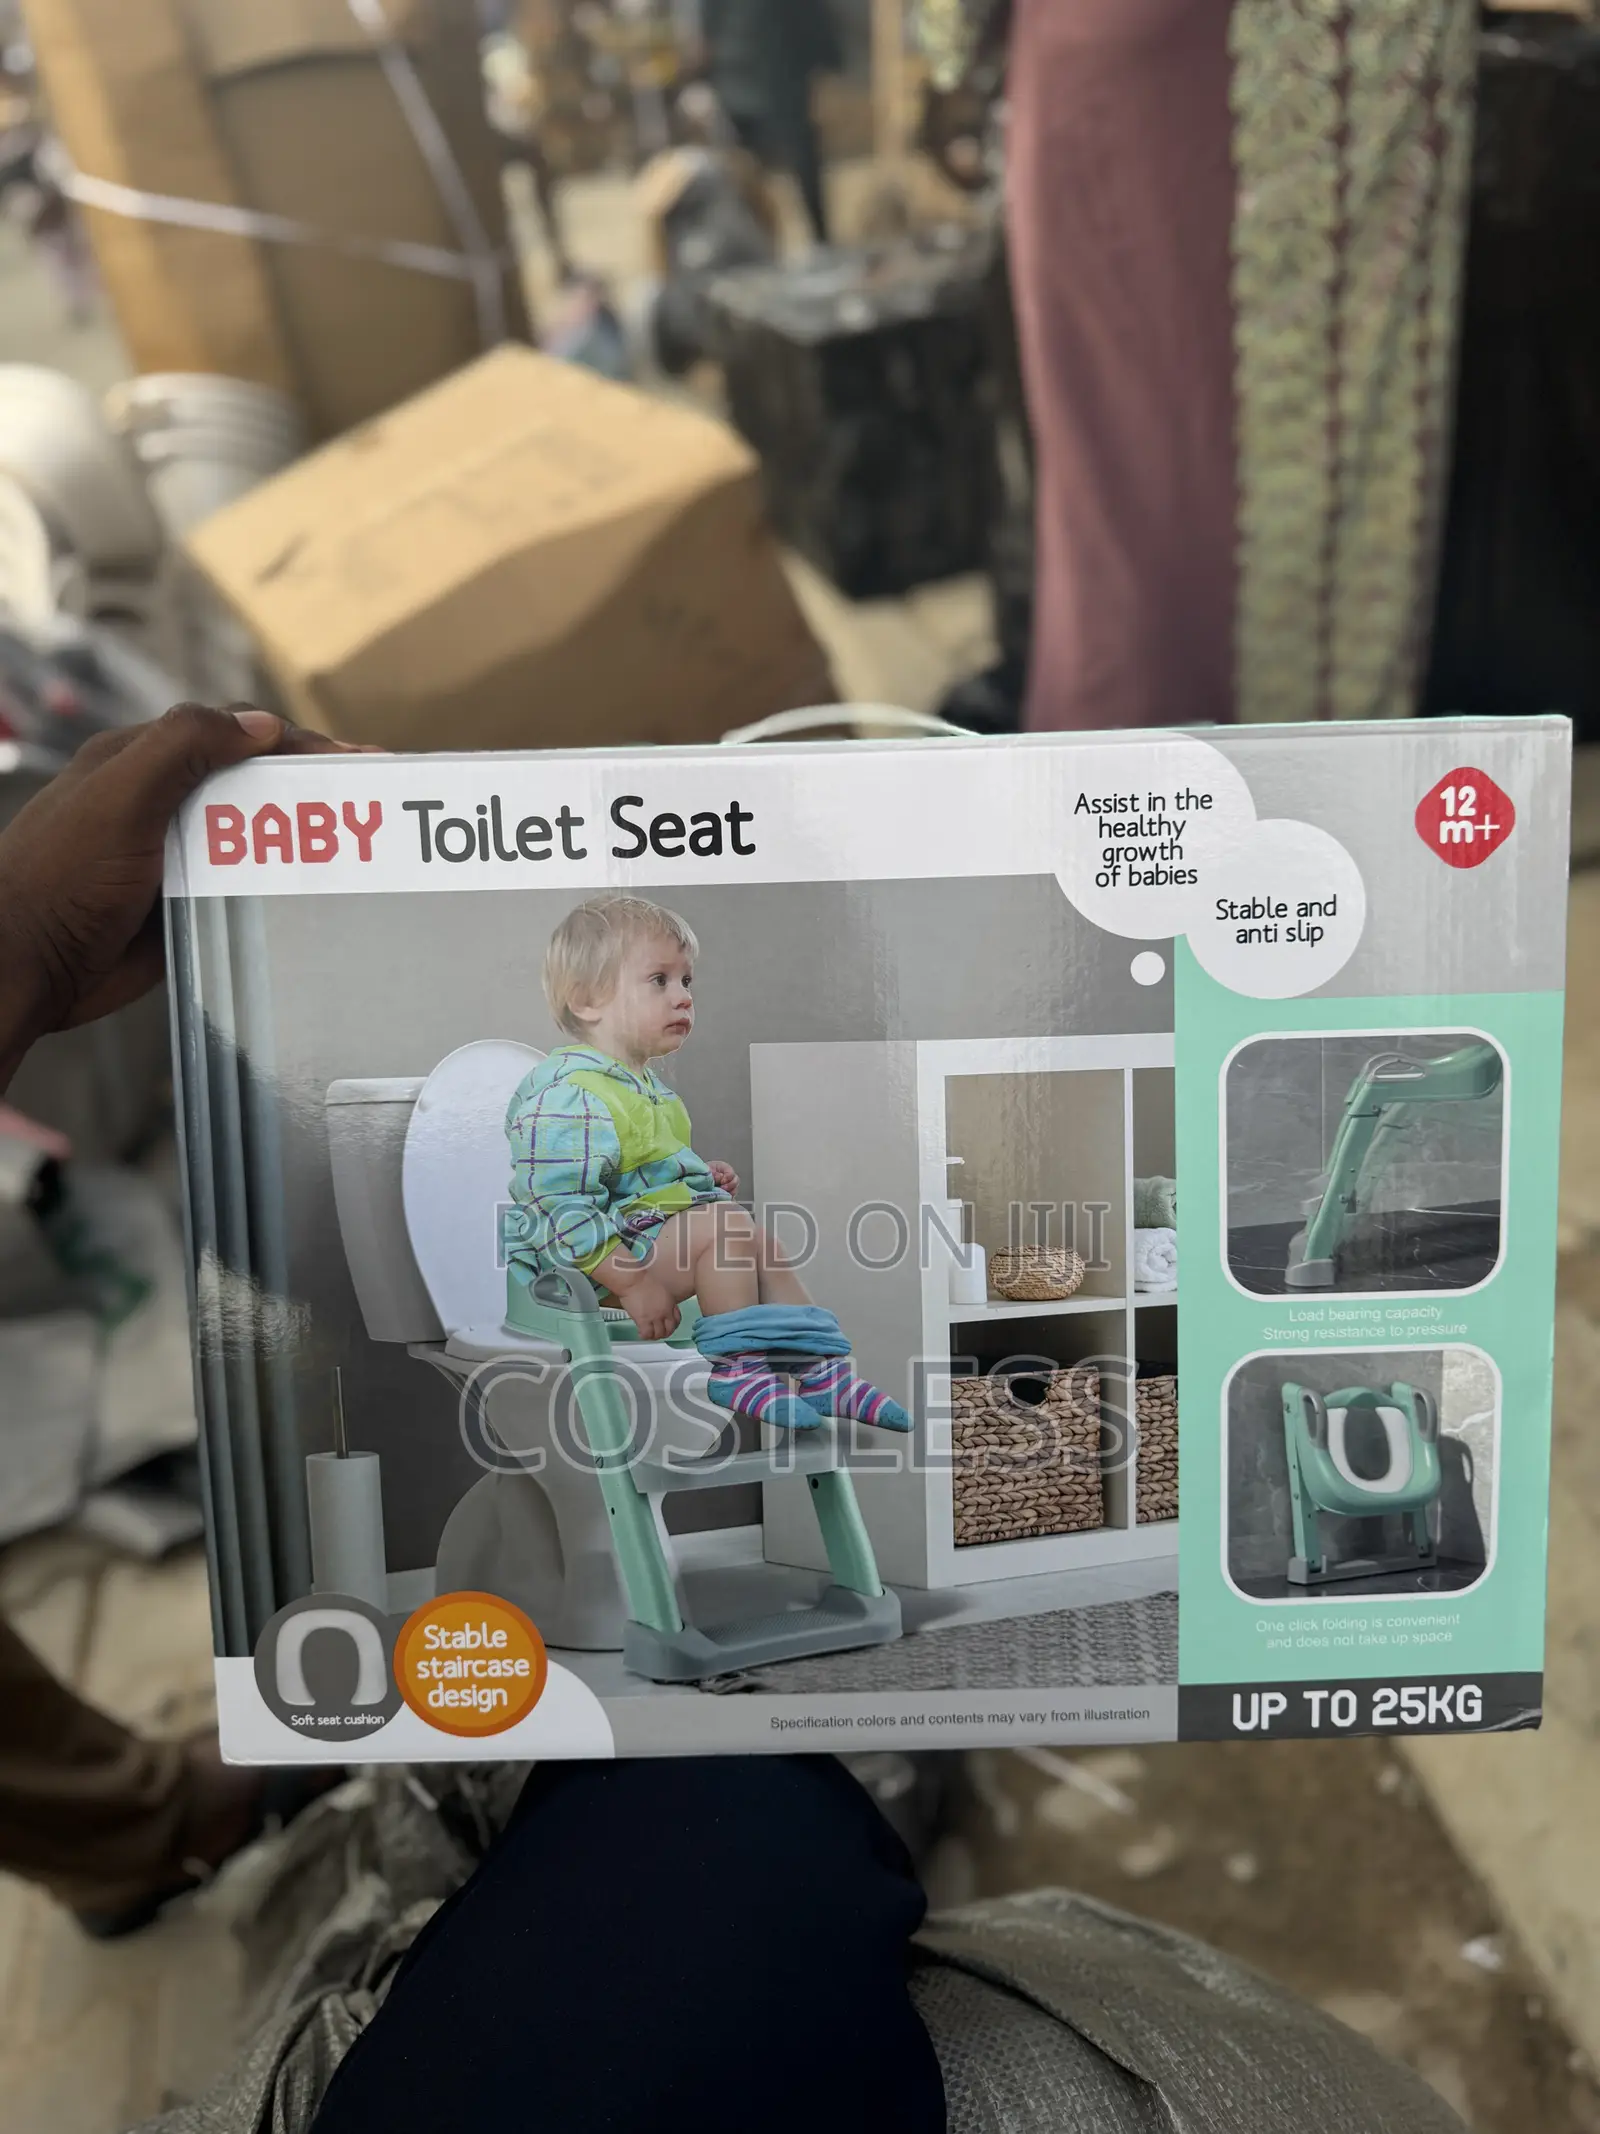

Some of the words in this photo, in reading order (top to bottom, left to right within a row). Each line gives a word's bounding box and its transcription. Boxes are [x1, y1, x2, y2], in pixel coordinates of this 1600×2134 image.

[1074, 792, 1139, 815] Assist
[1147, 792, 1166, 812] in
[1174, 788, 1213, 811] the
[1440, 786, 1476, 817] 12
[205, 800, 383, 866] BABY
[402, 795, 587, 863] Toilet
[610, 795, 756, 858] Seat
[1099, 816, 1186, 840] healthy
[1102, 840, 1183, 868] growth
[1095, 865, 1122, 887] of
[1128, 863, 1198, 886] babies
[1216, 897, 1288, 921] Stable
[1296, 894, 1337, 918] and
[1236, 922, 1278, 945] anti
[1285, 920, 1324, 948] slip
[1289, 1309, 1324, 1322] Load
[1329, 1307, 1381, 1323] bearing
[1385, 1306, 1442, 1321] capacity
[1263, 1327, 1310, 1342] Strong
[1314, 1325, 1386, 1338] resistance
[1390, 1325, 1403, 1337] to
[1407, 1322, 1467, 1338] pressure
[1256, 1620, 1284, 1633] One
[1289, 1618, 1318, 1632] click
[1322, 1617, 1368, 1632] folding
[1372, 1616, 1383, 1629] is
[1387, 1613, 1460, 1628] convenient
[424, 1621, 507, 1651] Stable
[1266, 1636, 1292, 1649] and
[1296, 1635, 1329, 1647] does
[1333, 1634, 1354, 1646] not
[1359, 1632, 1387, 1645] take
[1391, 1632, 1408, 1646] up
[1412, 1630, 1453, 1646] space
[417, 1655, 530, 1679] staircase
[428, 1682, 508, 1713] design
[1233, 1692, 1287, 1731] UP
[1303, 1689, 1357, 1728] TO
[1372, 1684, 1482, 1726] 25KG
[291, 1714, 314, 1726] Soft
[318, 1715, 341, 1725] seat
[344, 1713, 385, 1725] cushion
[770, 1715, 854, 1731] Specification
[857, 1713, 896, 1727] colors
[900, 1712, 925, 1726] and
[928, 1712, 984, 1725] contents
[987, 1711, 1015, 1725] may
[1019, 1710, 1047, 1723] vary
[1051, 1709, 1080, 1722] from
[1083, 1707, 1150, 1721] illustration
